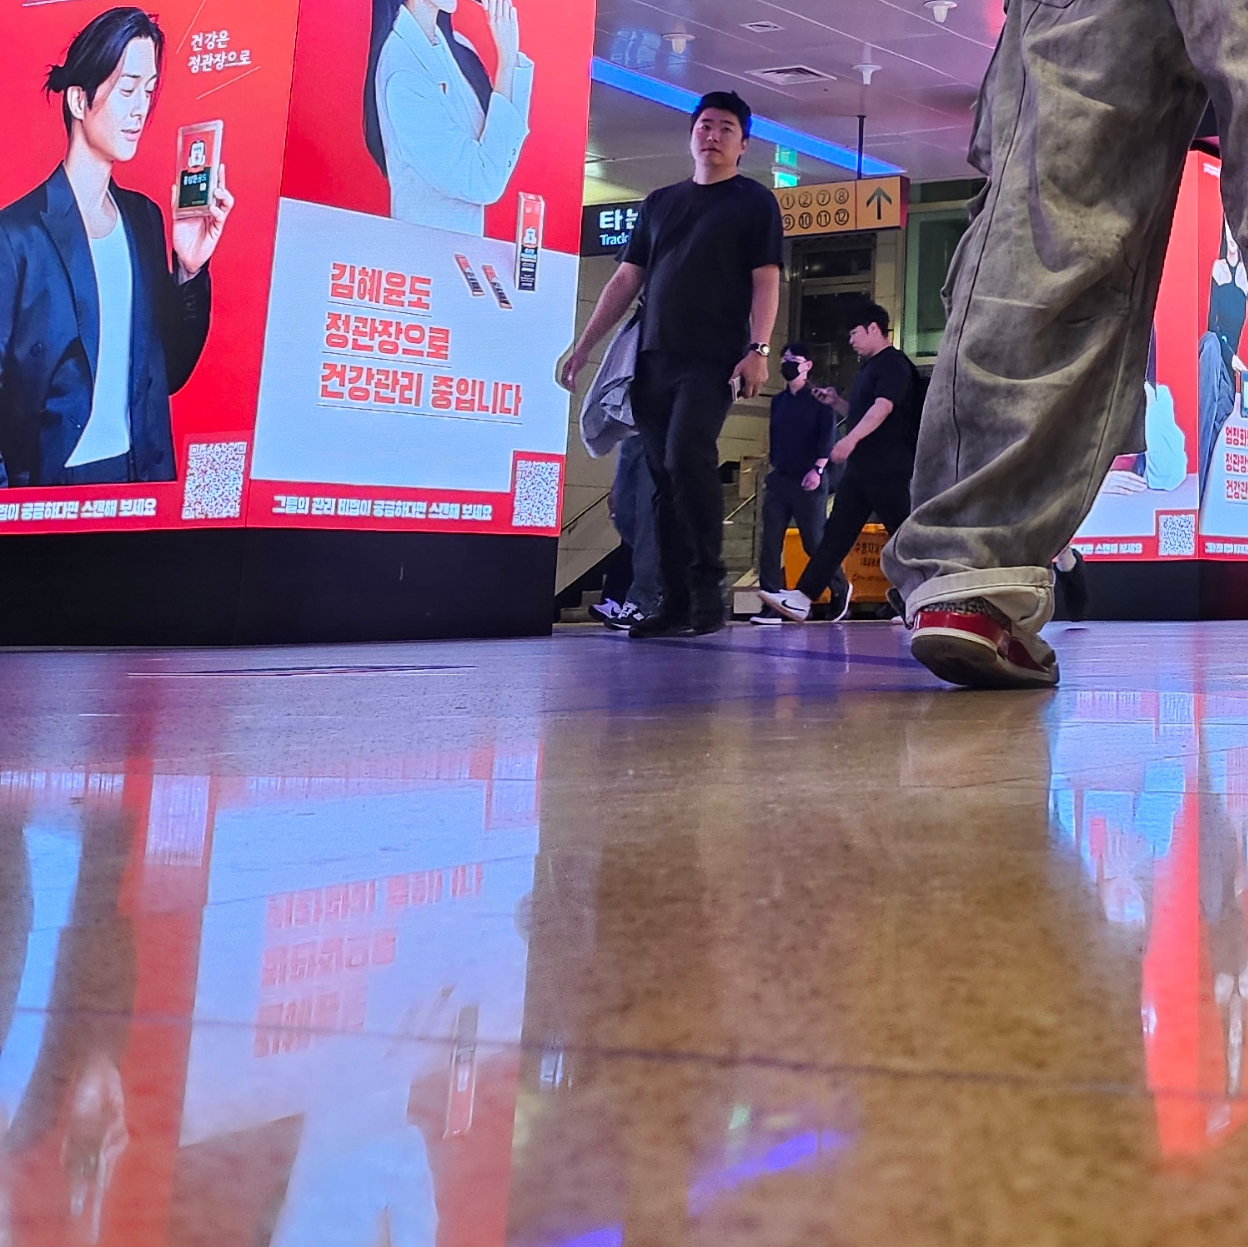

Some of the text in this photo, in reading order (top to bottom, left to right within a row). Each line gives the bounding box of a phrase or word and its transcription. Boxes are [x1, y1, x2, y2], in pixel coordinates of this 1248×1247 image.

[190, 29, 230, 52] 건강은
[187, 49, 252, 74] 정관장으로
[598, 232, 631, 246] Track
[330, 262, 432, 310] 김혜윤도
[324, 311, 451, 362] 정관장으로
[320, 362, 523, 418] 건강관리 중입니다
[20, 500, 79, 522] 궁금하다면
[80, 499, 118, 518] 스캔해
[118, 498, 157, 517] 보세요
[272, 494, 309, 514] 그들의
[311, 496, 336, 516] 관리
[373, 499, 428, 520] 궁금하다면
[428, 502, 460, 520] 스캔해
[461, 503, 492, 521] 보세요
